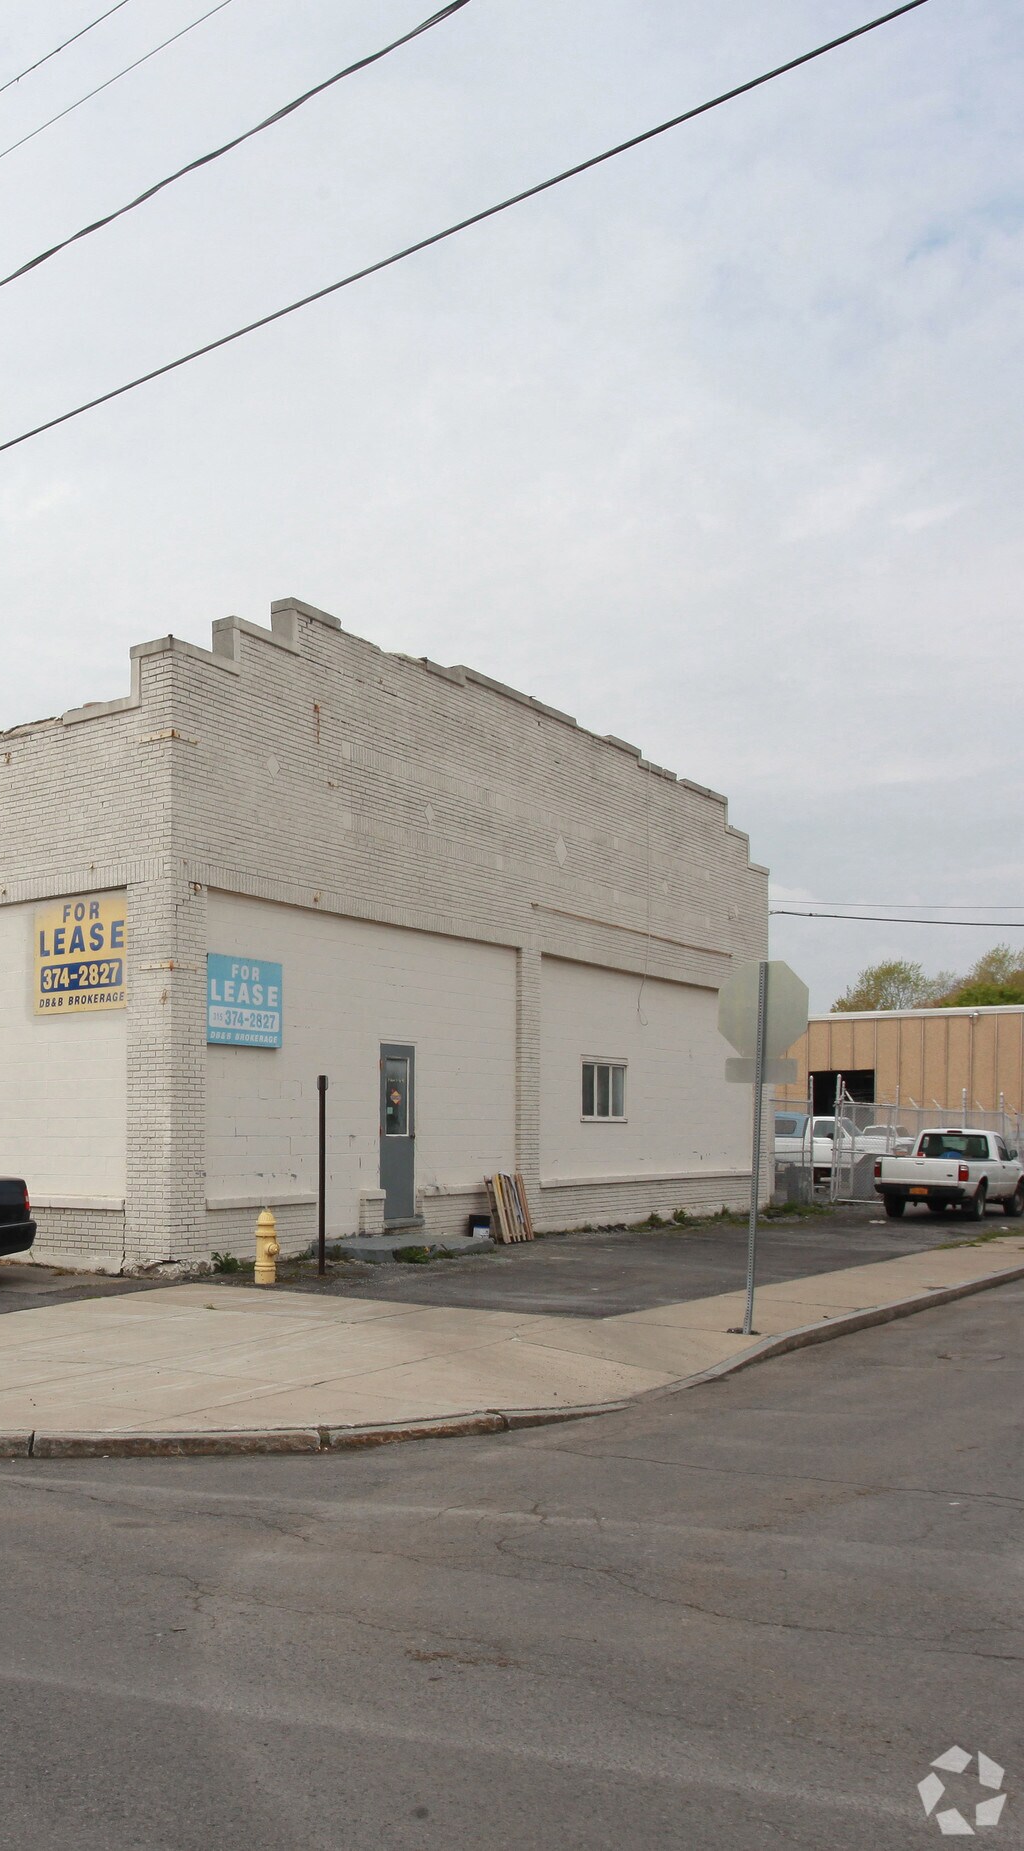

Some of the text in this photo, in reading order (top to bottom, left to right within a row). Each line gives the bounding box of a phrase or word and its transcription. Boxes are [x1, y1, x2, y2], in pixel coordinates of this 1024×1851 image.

[63, 901, 100, 923] FOR
[39, 920, 125, 957] LEASE
[42, 962, 120, 990] 374-2827
[231, 964, 260, 982] FOR
[39, 991, 125, 1009] DB&B BROKERAGE
[210, 979, 278, 1007] LEASE
[224, 1010, 276, 1029] 374-2827
[235, 1033, 278, 1043] BROKERAGE
